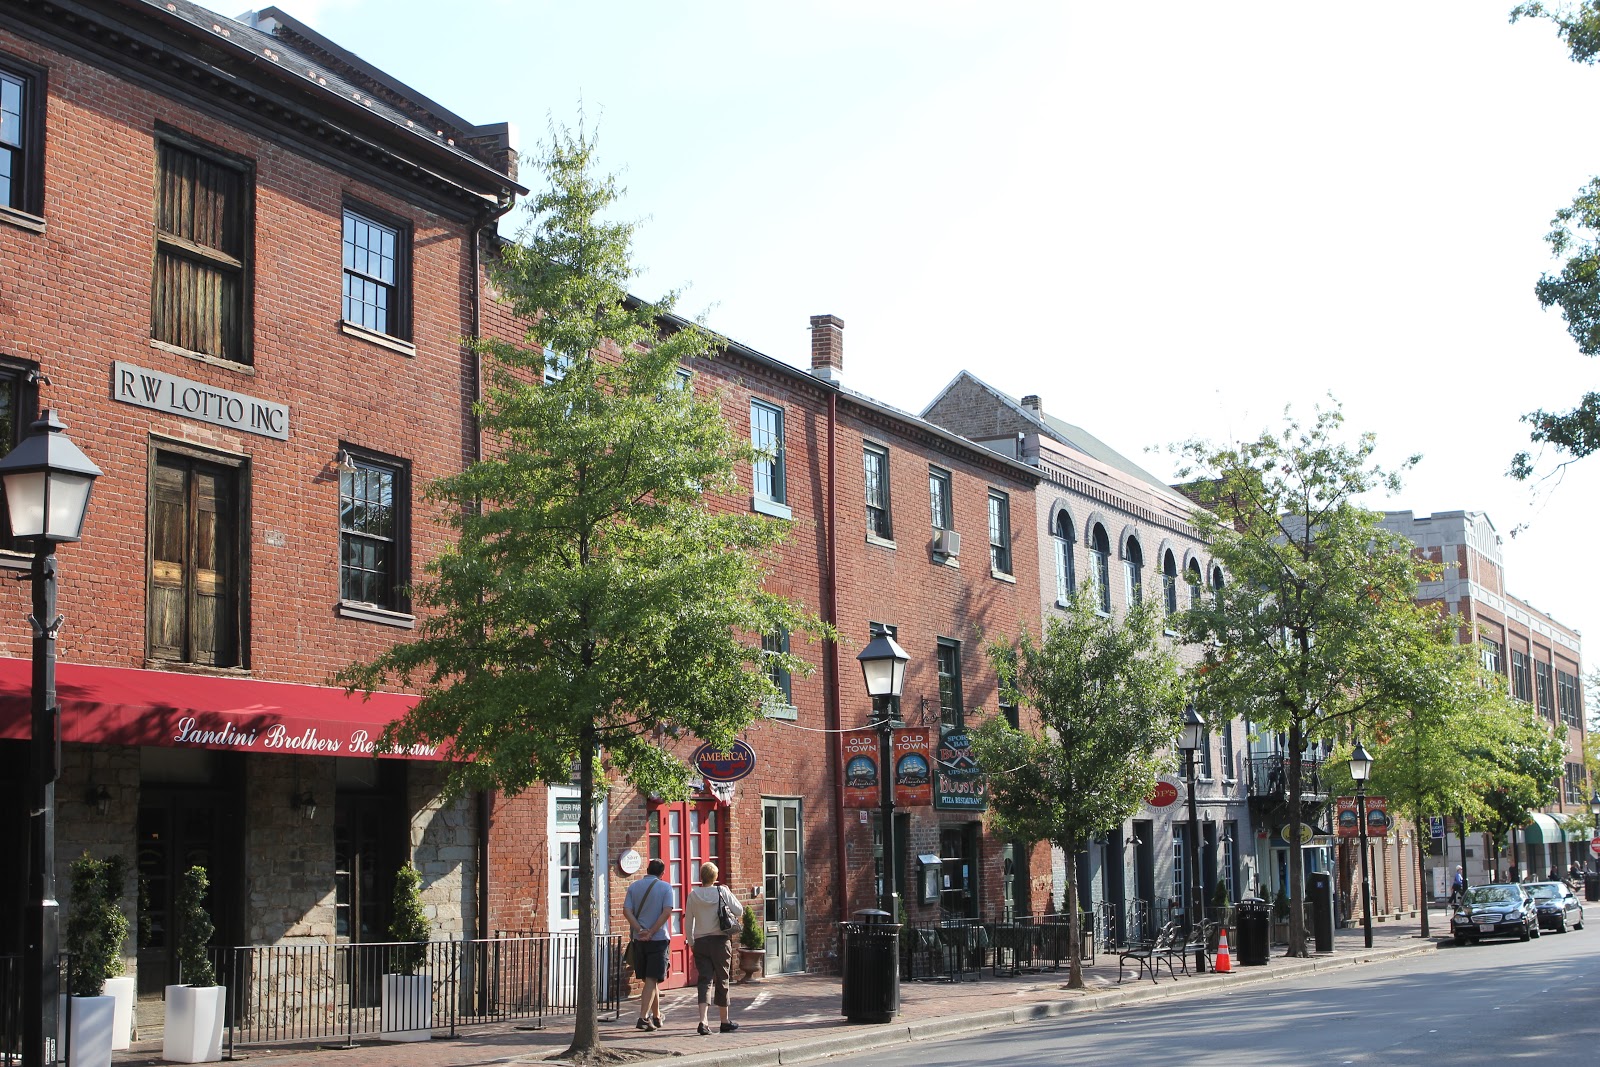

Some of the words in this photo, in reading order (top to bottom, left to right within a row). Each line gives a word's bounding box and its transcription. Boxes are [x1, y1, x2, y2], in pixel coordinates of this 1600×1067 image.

[170, 382, 244, 423] LOTTO
[250, 402, 283, 433] INC
[173, 716, 259, 747] Landini
[264, 723, 343, 752] Brothers
[947, 734, 968, 742] SPOR
[901, 735, 924, 743] OLD
[845, 745, 877, 753] TOWN
[699, 752, 747, 762] AMERICA!
[947, 767, 980, 776] UPSTAIRS
[941, 796, 955, 804] PIZZA
[556, 803, 571, 811] SILVER
[572, 803, 582, 811] PAR
